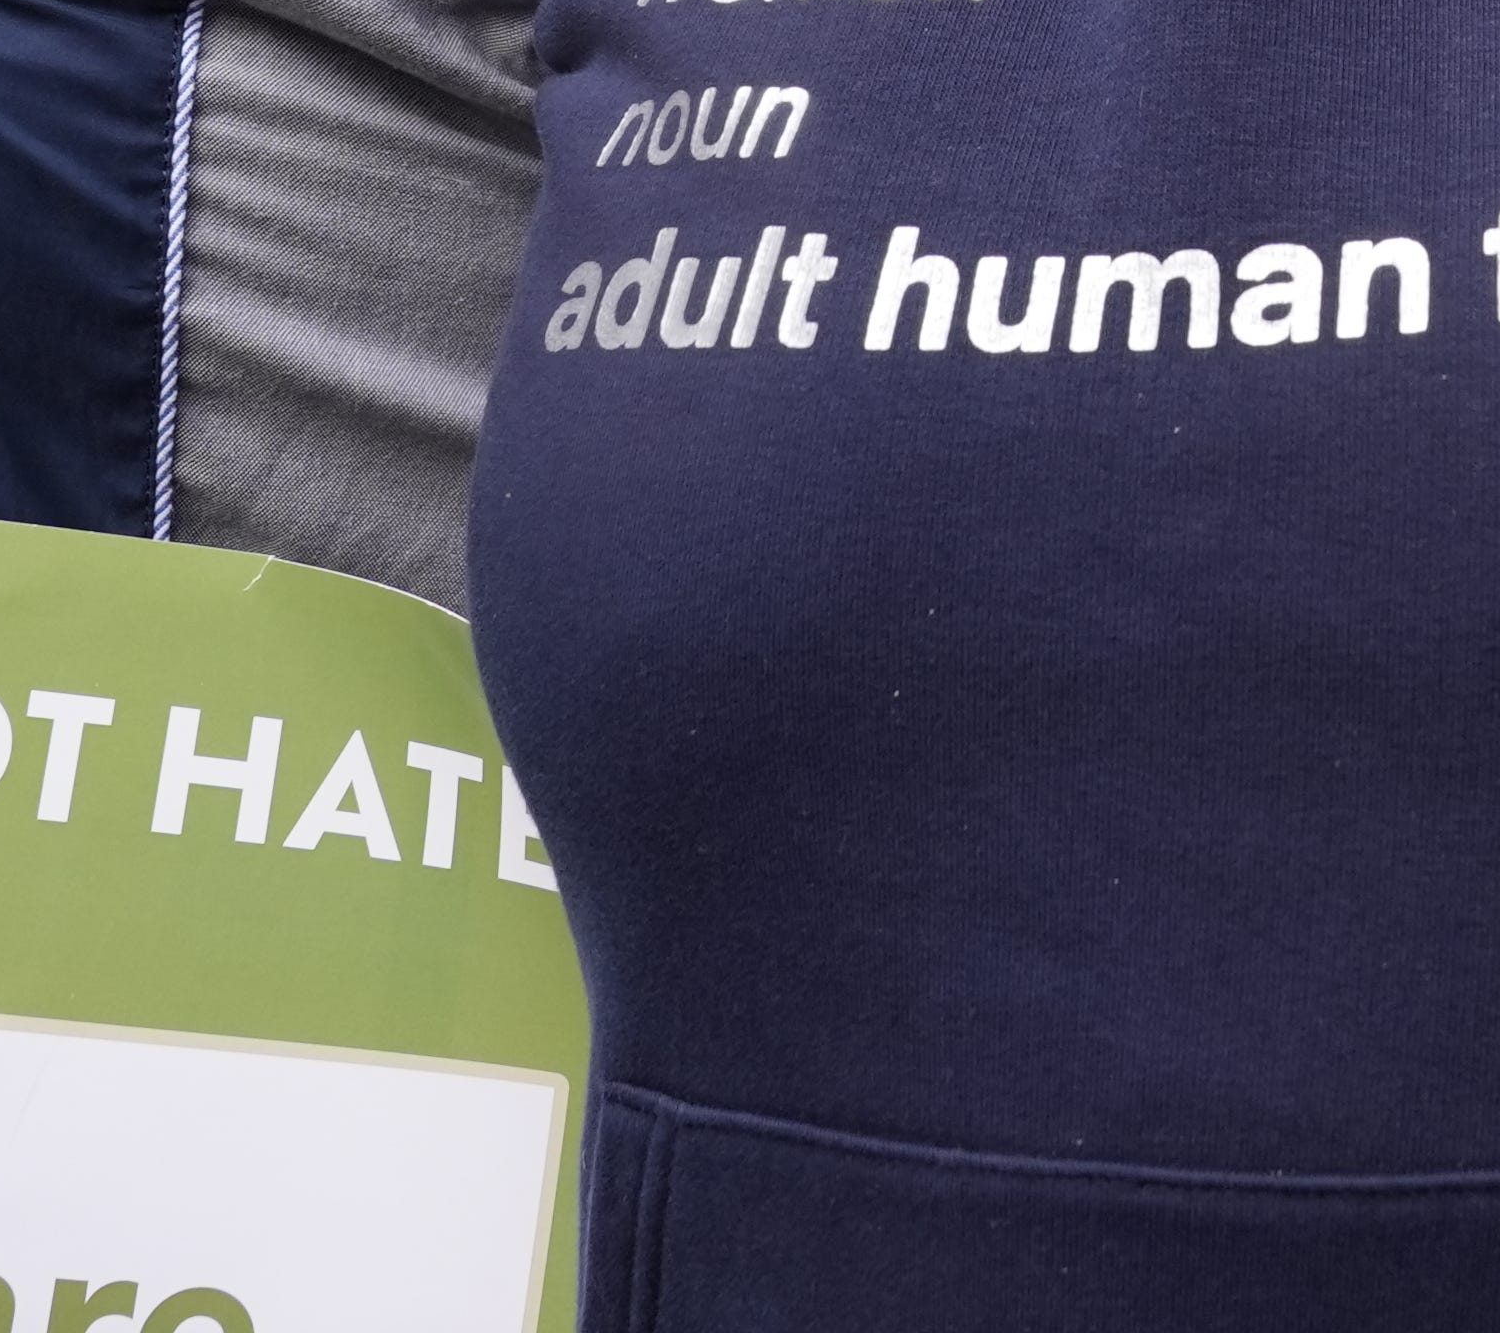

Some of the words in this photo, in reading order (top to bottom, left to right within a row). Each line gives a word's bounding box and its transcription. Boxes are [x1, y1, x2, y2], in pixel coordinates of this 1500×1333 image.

[595, 83, 812, 168] noun
[544, 223, 840, 354] adult
[863, 224, 1432, 355] human
